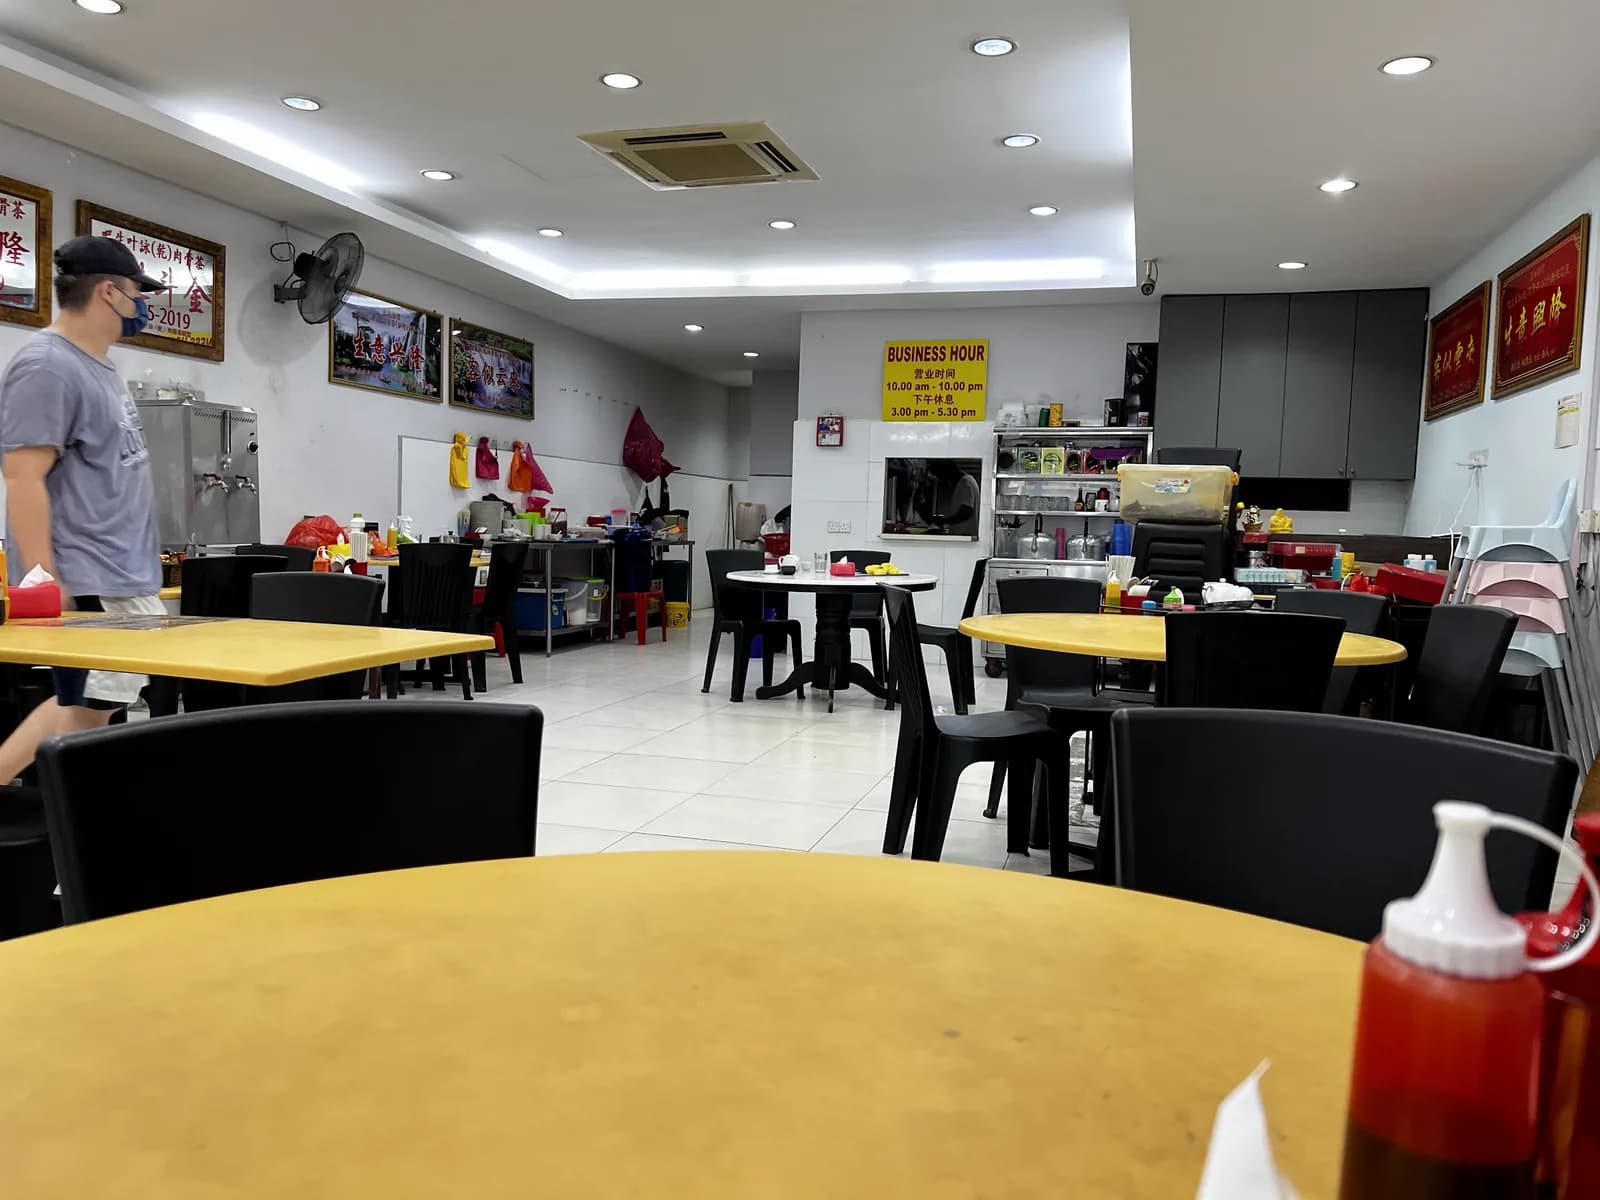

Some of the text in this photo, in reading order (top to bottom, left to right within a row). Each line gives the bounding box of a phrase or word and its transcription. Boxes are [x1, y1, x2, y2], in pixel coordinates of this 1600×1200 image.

[887, 344, 985, 362] BUSINESS HOUR
[914, 368, 956, 379] 营业时间
[887, 382, 912, 391] 10.00
[914, 383, 929, 391] am
[938, 381, 965, 391] 10.00
[968, 383, 983, 392] pm
[913, 394, 954, 405] 下午休息
[891, 407, 911, 417] 3.00
[914, 409, 929, 419] pm
[937, 407, 958, 417] 5.30
[961, 409, 976, 418] pm
